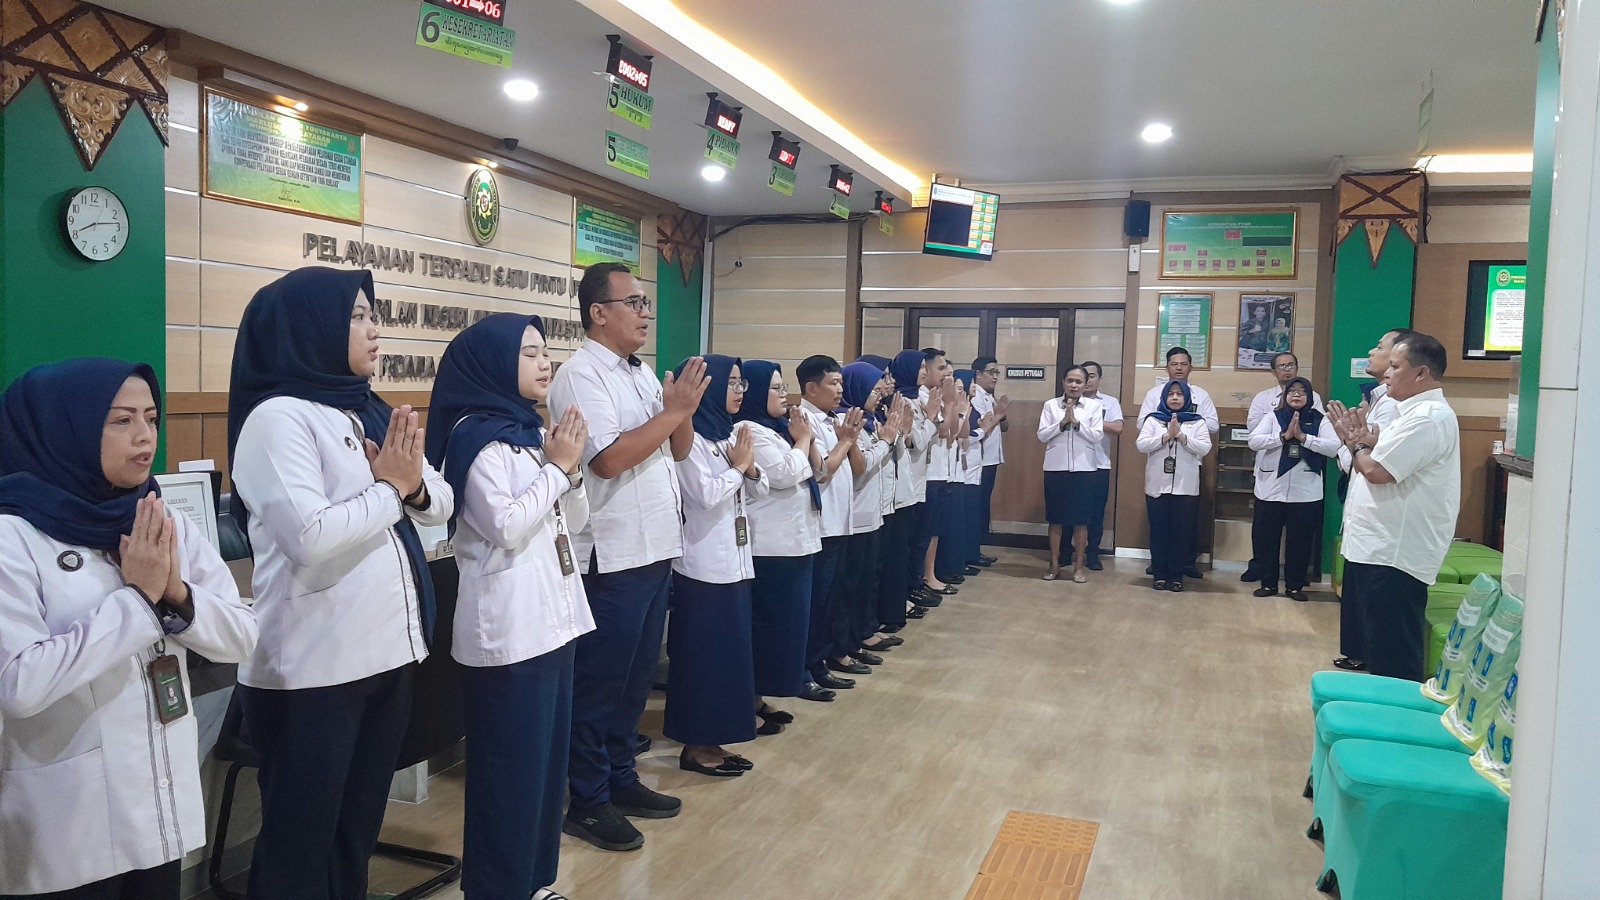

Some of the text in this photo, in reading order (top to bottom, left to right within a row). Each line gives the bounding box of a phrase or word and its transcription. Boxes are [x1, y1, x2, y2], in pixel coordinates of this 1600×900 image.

[421, 11, 514, 48] 6 KESEKRETARIATAN
[609, 83, 651, 112] 5 HUKUM
[607, 136, 617, 162] 5
[706, 133, 738, 156] 4 PIDANA
[768, 165, 778, 186] 3
[81, 195, 87, 205] 11
[90, 193, 98, 203] 12
[105, 199, 108, 208] 1
[73, 204, 80, 214] 10
[112, 209, 118, 220] 2
[69, 215, 75, 225] 9
[73, 230, 79, 240] 8
[111, 235, 117, 244] 4
[82, 240, 87, 250] 7
[92, 245, 98, 255] 6
[104, 243, 109, 252] 5
[302, 232, 415, 274] PELAYANAN
[419, 253, 491, 284] TERPADU
[494, 265, 529, 290] SATU
[1024, 369, 1043, 377] PETUGAS
